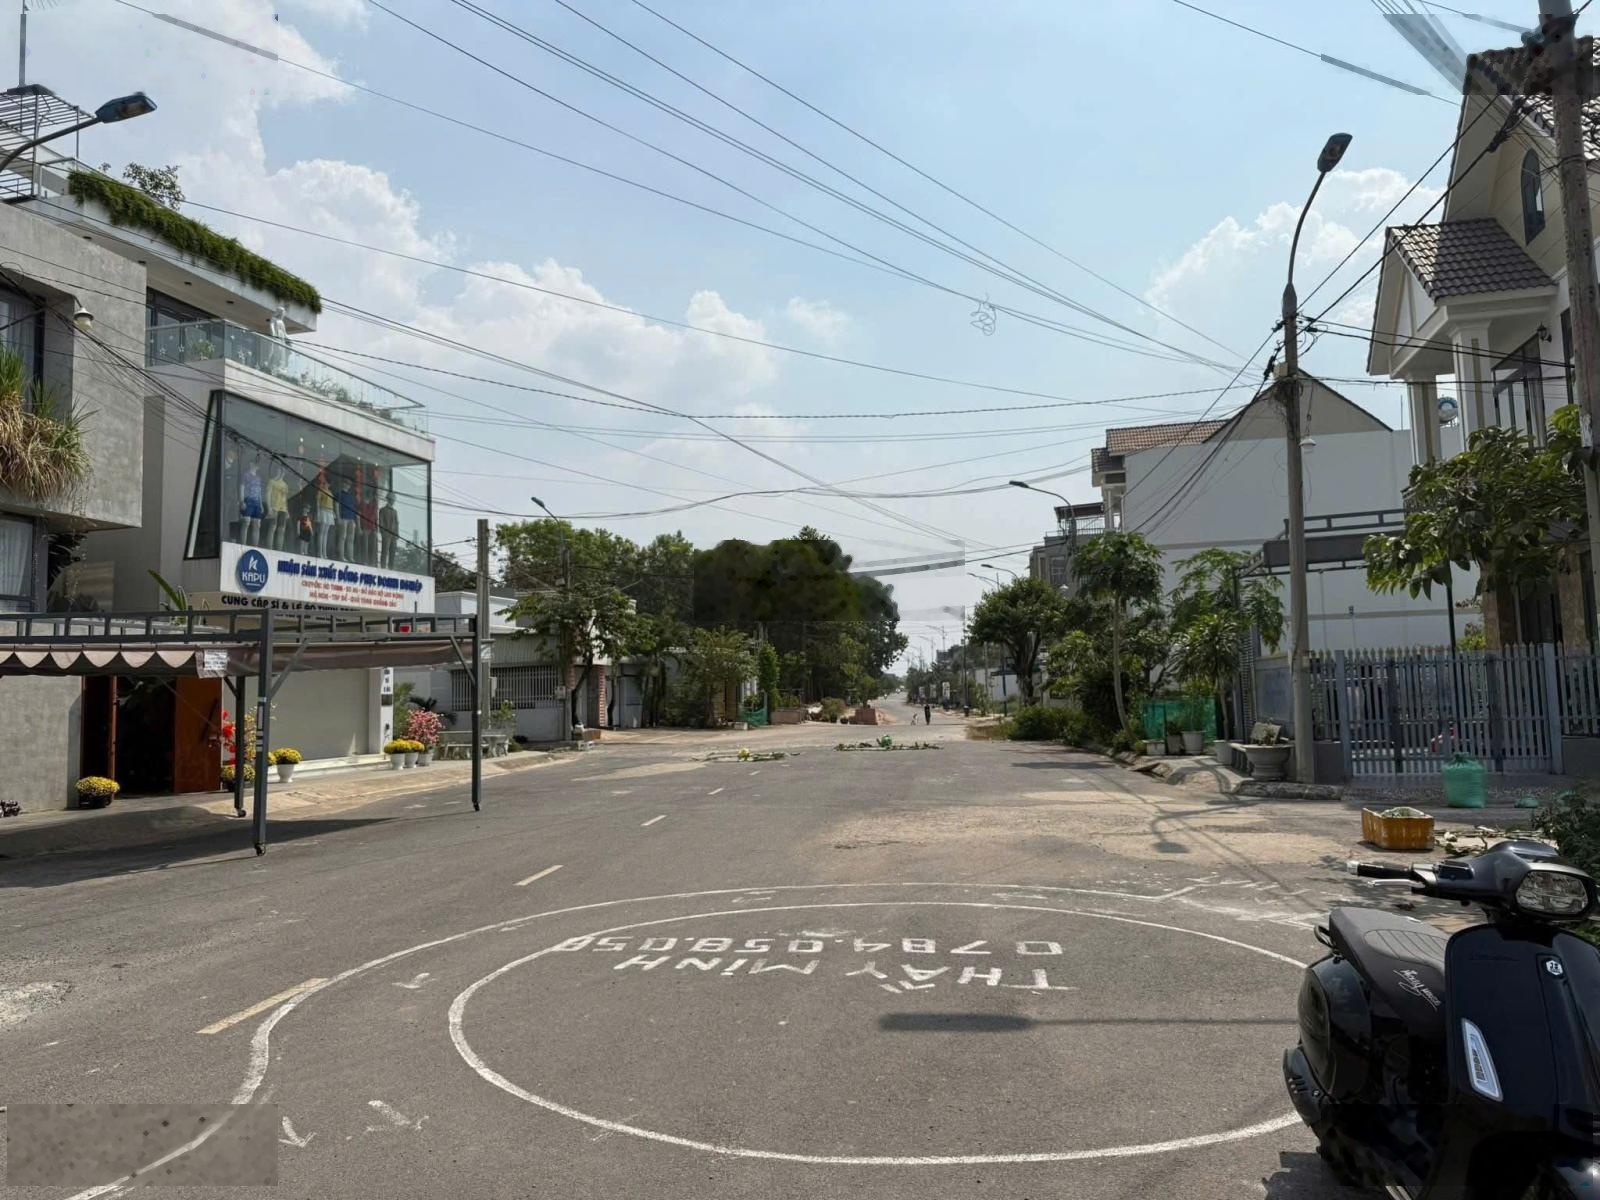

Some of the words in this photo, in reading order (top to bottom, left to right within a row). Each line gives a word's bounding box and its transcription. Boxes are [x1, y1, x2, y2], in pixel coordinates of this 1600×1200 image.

[242, 571, 265, 583] KAPU
[221, 595, 248, 607] CUNG
[282, 601, 289, 610] &
